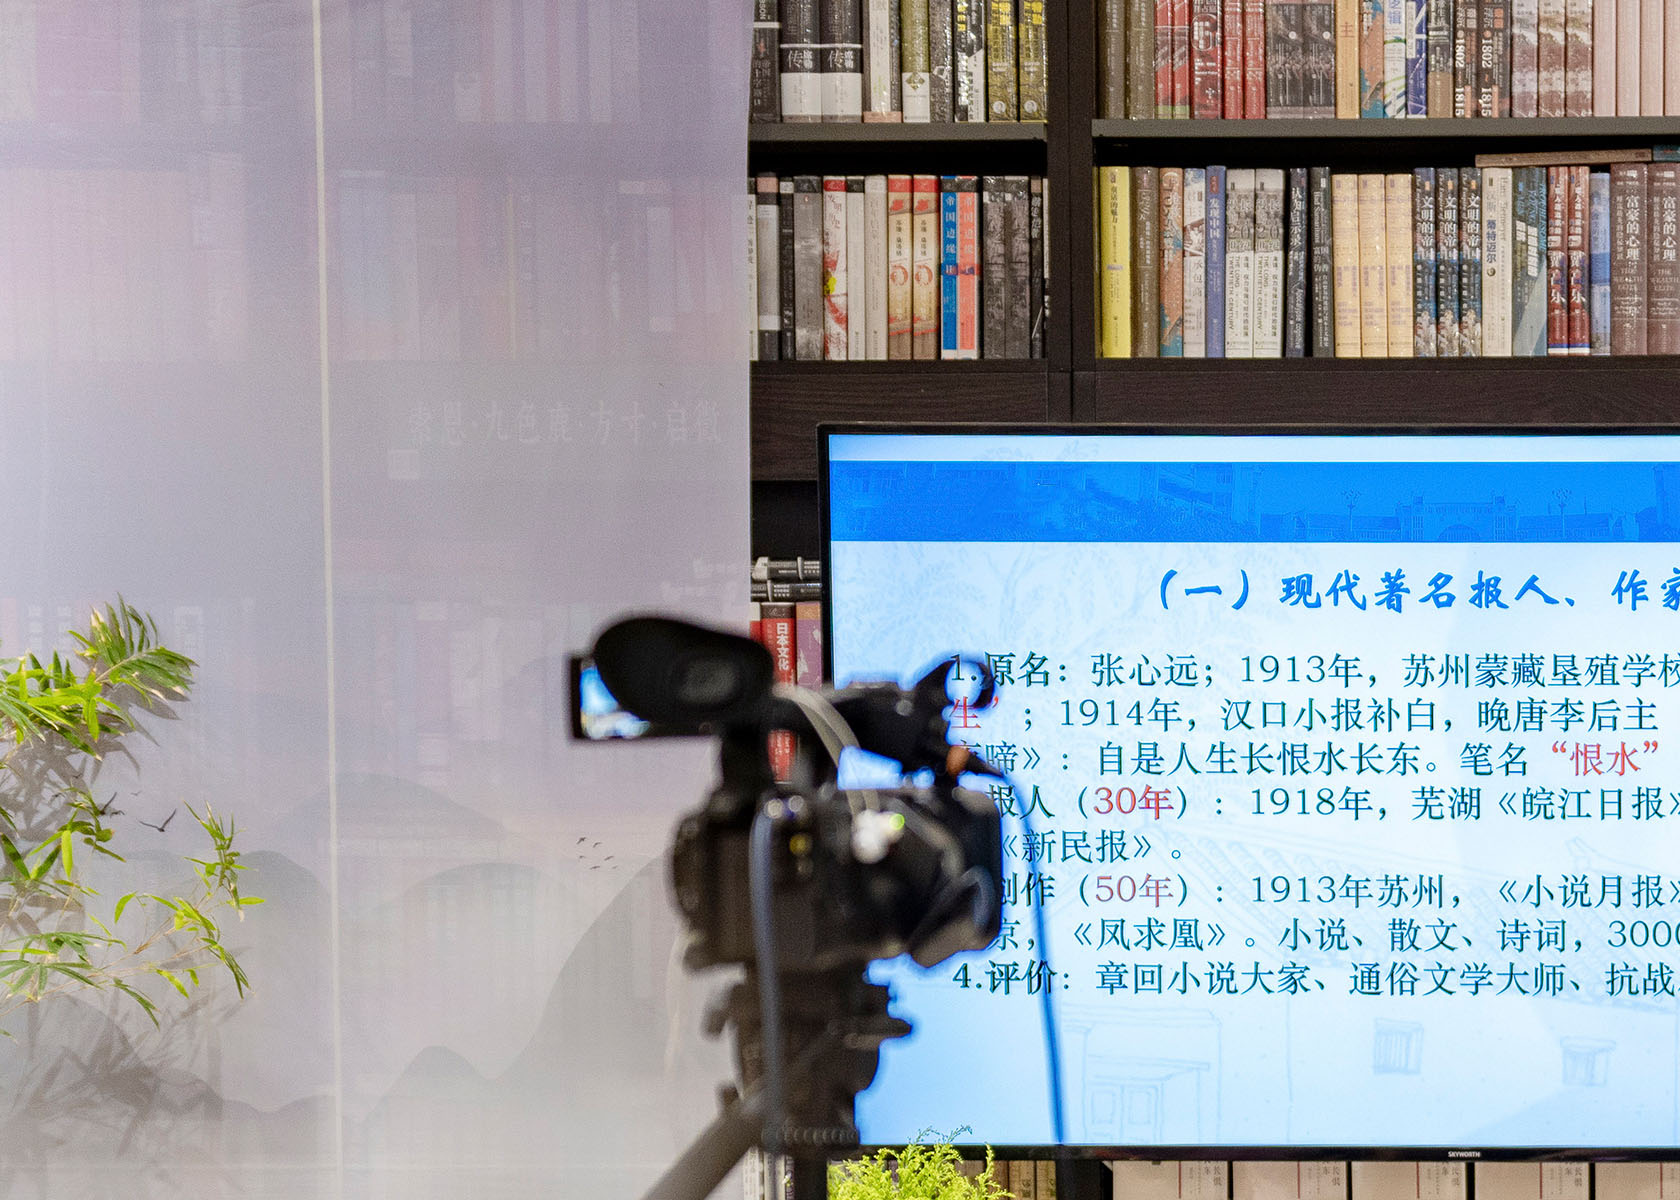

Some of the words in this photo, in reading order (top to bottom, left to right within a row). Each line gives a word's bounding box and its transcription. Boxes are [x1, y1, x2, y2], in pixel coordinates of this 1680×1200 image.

[1626, 195, 1640, 261] 富豪的心理
[1663, 195, 1677, 261] 富豪的心理
[776, 621, 789, 671] 日本文化
